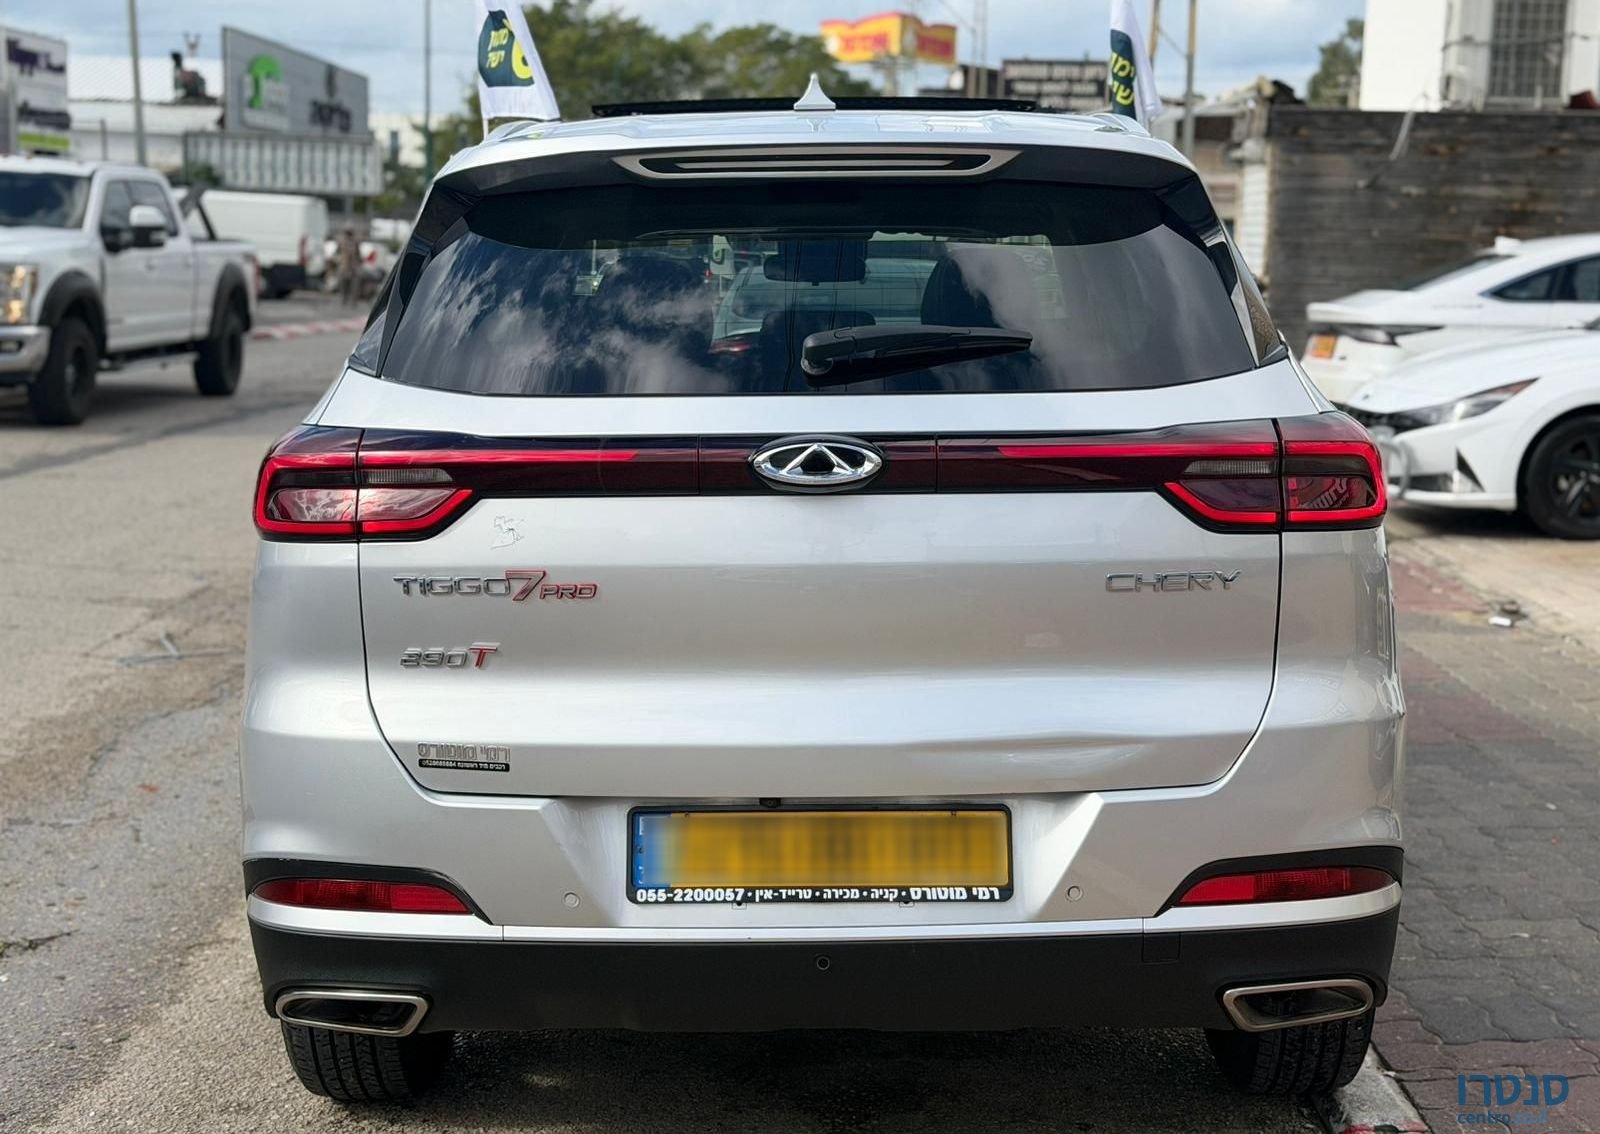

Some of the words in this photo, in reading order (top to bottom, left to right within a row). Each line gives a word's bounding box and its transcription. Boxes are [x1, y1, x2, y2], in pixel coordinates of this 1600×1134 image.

[1105, 568, 1242, 593] CHERY
[636, 888, 744, 902] 055-2200057
[754, 888, 812, 902] טרייד-אין
[822, 888, 860, 899] מכירה
[870, 888, 898, 901] קניה
[909, 887, 967, 900] מוטורס
[972, 887, 1001, 900] רמי
